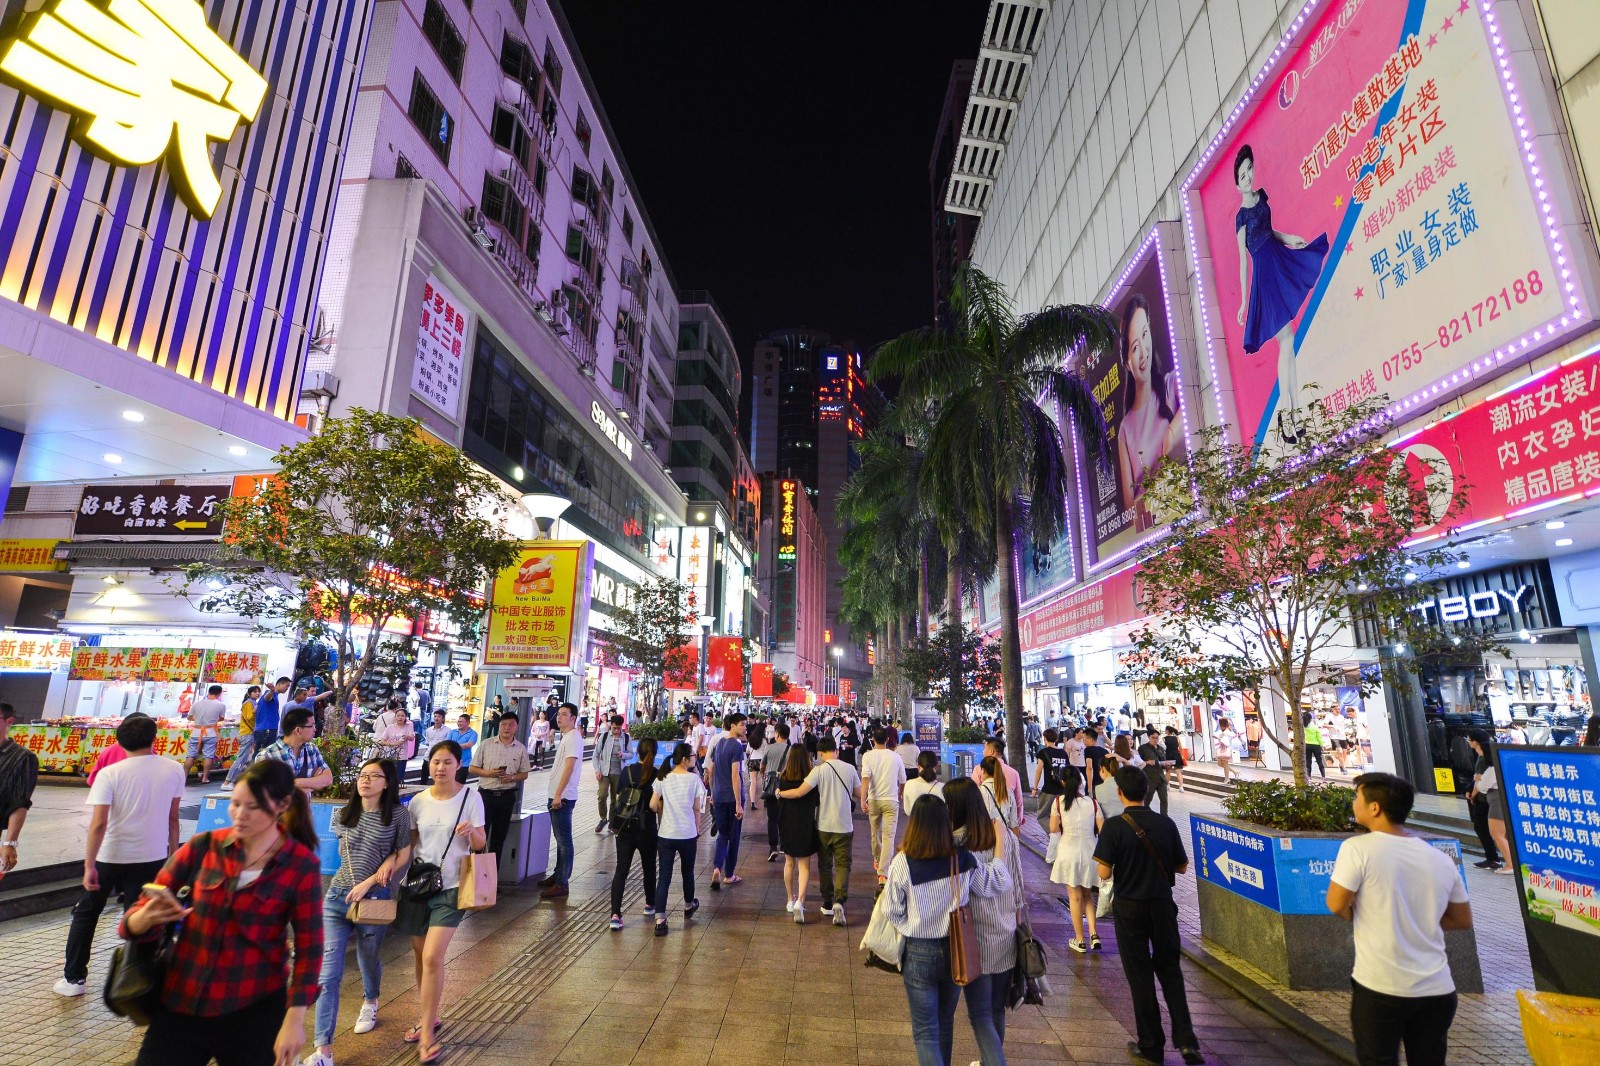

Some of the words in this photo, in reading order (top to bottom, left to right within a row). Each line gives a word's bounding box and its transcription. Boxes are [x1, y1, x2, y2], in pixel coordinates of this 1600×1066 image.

[1301, 37, 1422, 187] 东门最大集散基地
[1347, 78, 1439, 179] 中老年女装
[1353, 106, 1447, 202] 零售片区
[1363, 145, 1457, 243] 婚纱新娘装
[1504, 451, 1600, 507] 精品唐装
[80, 494, 218, 517] 好吃香快餐厅
[498, 605, 566, 618] 中国专业服饰
[505, 620, 555, 631] 批发市场
[0, 640, 72, 658] 新鲜水果
[505, 635, 538, 645] 欢迎您
[76, 651, 141, 668] 新鲜水果
[149, 652, 198, 669] 新鲜水果
[214, 651, 260, 672] 新鲜水果
[1526, 762, 1579, 781] 温馨提示
[1518, 801, 1600, 827] 需要您的支持
[1196, 821, 1265, 852] 人员密集紧急疏散方向指示
[1522, 821, 1600, 848] 乱扔垃圾罚款
[1228, 861, 1257, 883] 解放东路
[1529, 872, 1595, 898] 创文明街区
